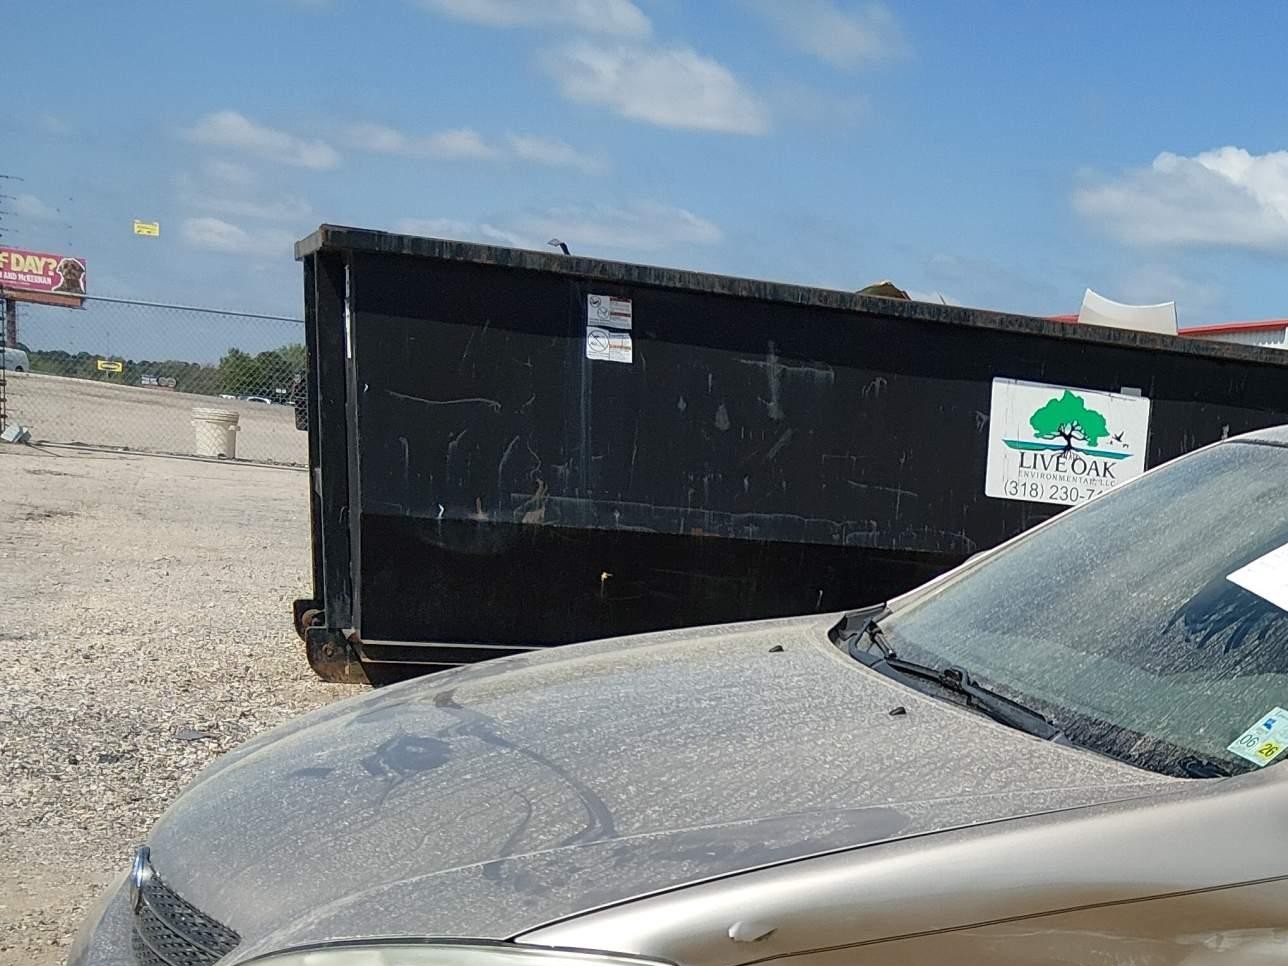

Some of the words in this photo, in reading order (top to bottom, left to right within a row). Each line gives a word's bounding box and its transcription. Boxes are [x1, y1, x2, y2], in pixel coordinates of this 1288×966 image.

[11, 253, 57, 276] DAY?
[1004, 480, 1044, 499] (318)
[1049, 485, 1103, 502] 230-7
[1239, 734, 1259, 748] 06
[1258, 743, 1279, 757] 26
